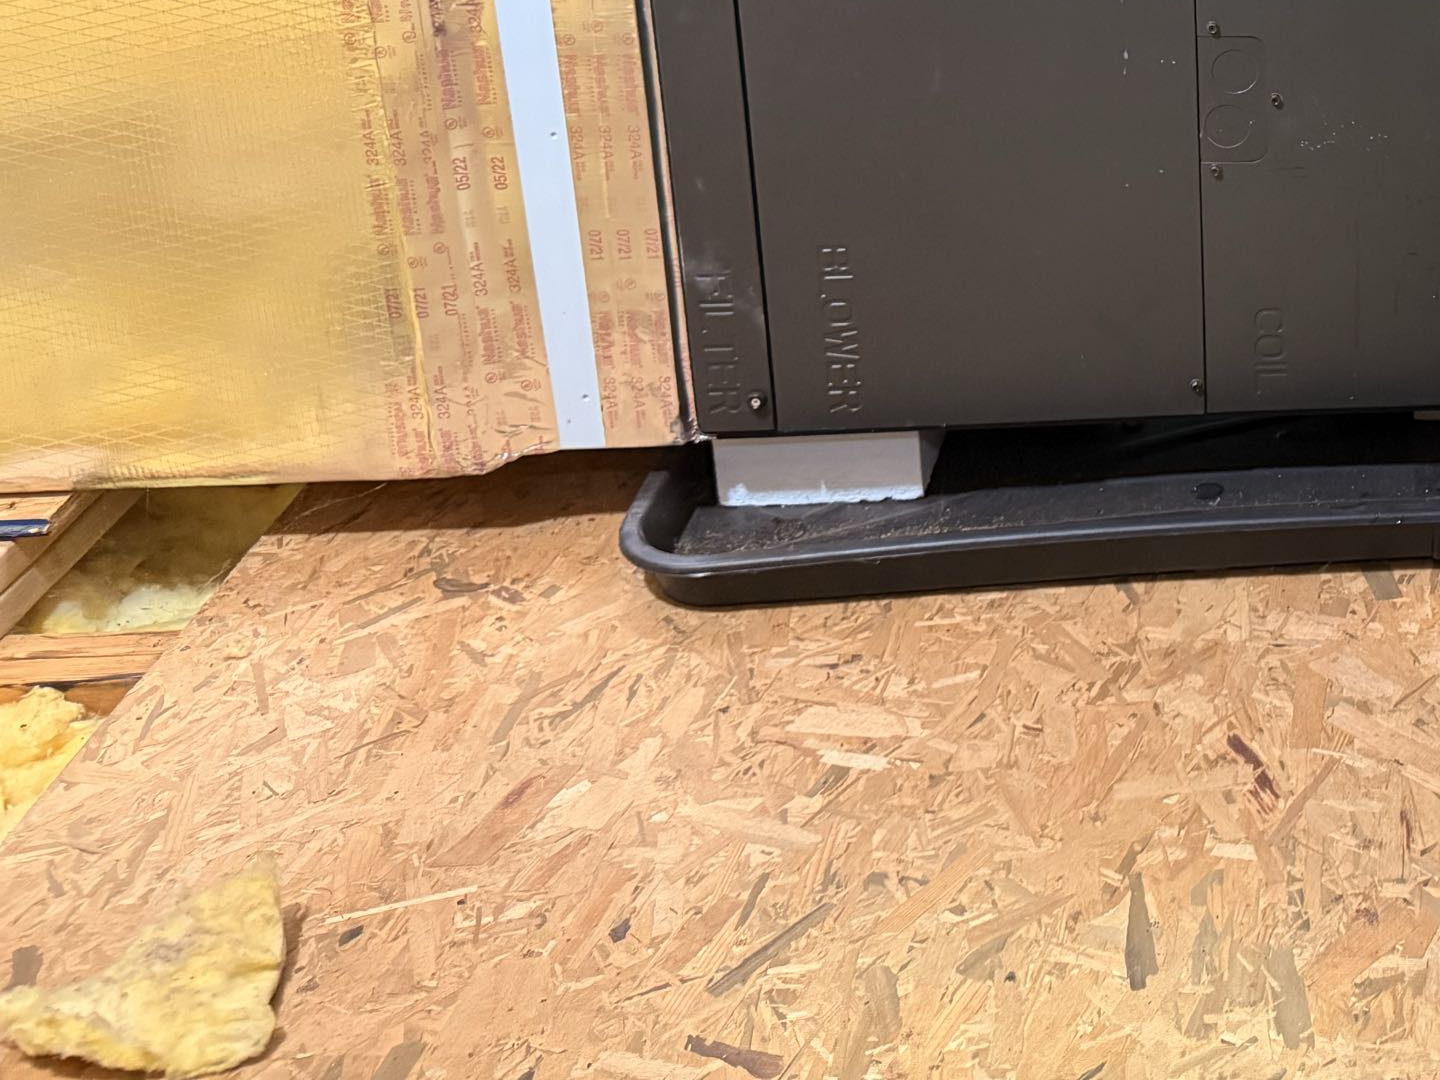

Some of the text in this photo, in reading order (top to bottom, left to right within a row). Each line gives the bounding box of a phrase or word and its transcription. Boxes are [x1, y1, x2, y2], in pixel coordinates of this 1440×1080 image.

[452, 156, 470, 191] 05/22
[490, 156, 508, 191] 05/22
[588, 230, 603, 261] 07/21
[616, 229, 632, 261] 07/21
[469, 261, 488, 298] 324A
[503, 257, 522, 294] 324A
[816, 244, 865, 415] BLOWER
[1253, 306, 1289, 396] COIL
